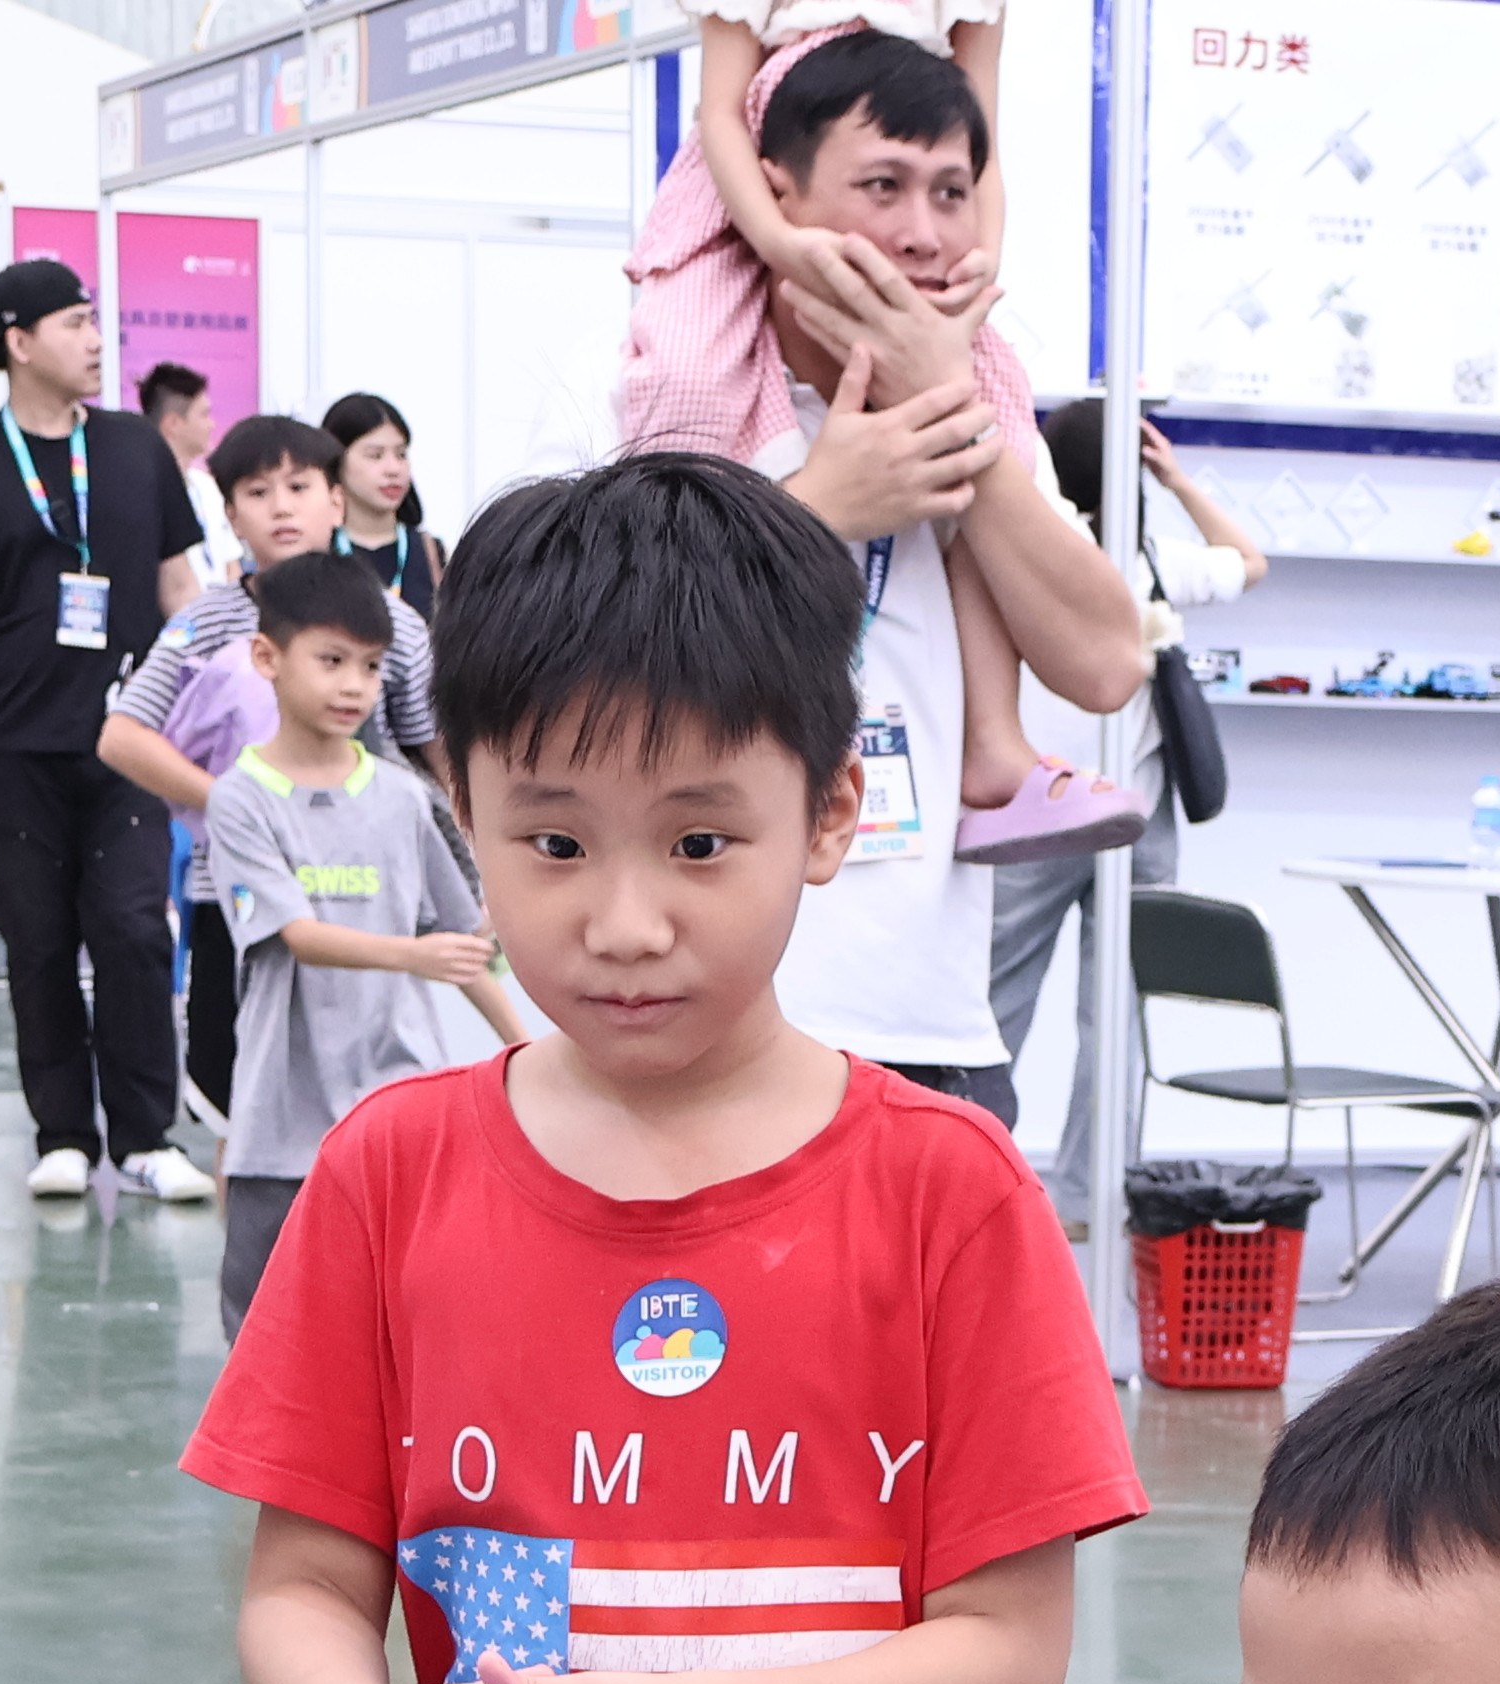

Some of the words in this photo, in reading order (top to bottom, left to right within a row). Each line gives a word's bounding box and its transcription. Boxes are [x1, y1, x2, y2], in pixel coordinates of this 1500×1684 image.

[1192, 26, 1312, 74] 回力类
[640, 1293, 698, 1321] IBTE
[632, 1365, 707, 1382] VISITOR
